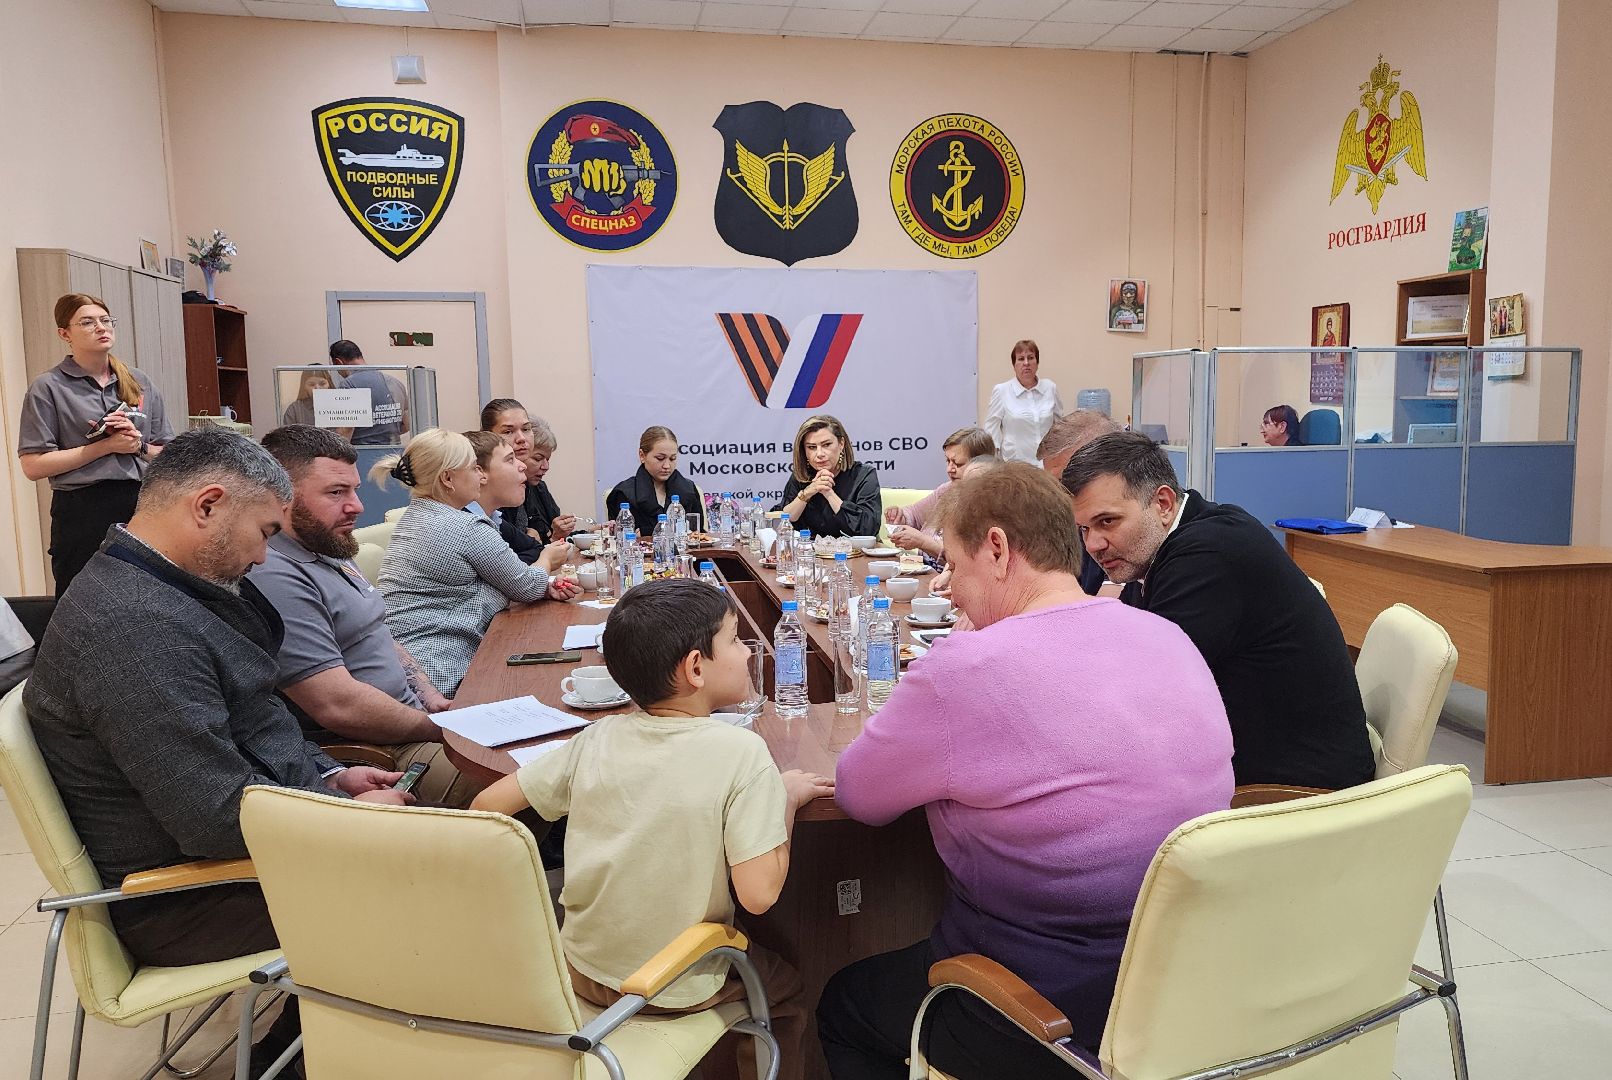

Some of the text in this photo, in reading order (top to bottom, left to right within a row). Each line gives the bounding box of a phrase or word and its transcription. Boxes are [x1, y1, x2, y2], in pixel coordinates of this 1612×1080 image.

[326, 112, 450, 142] РОССИЯ
[895, 117, 1021, 177] МОРСКАЯ ПЕХОТА РОССИИ
[346, 171, 439, 185] ПОДВОДНЫЕ
[372, 186, 416, 199] СИЛЫ
[571, 214, 637, 232] СПЕЦНАЗ
[911, 227, 932, 247] ГДЕ
[955, 245, 978, 256] ТАМ
[984, 205, 1018, 248] ПОБЕДА!
[1327, 211, 1427, 250] РОСГВАРДИЯ
[678, 442, 776, 456] социация
[888, 436, 929, 451] СВО
[689, 461, 794, 476] Московск
